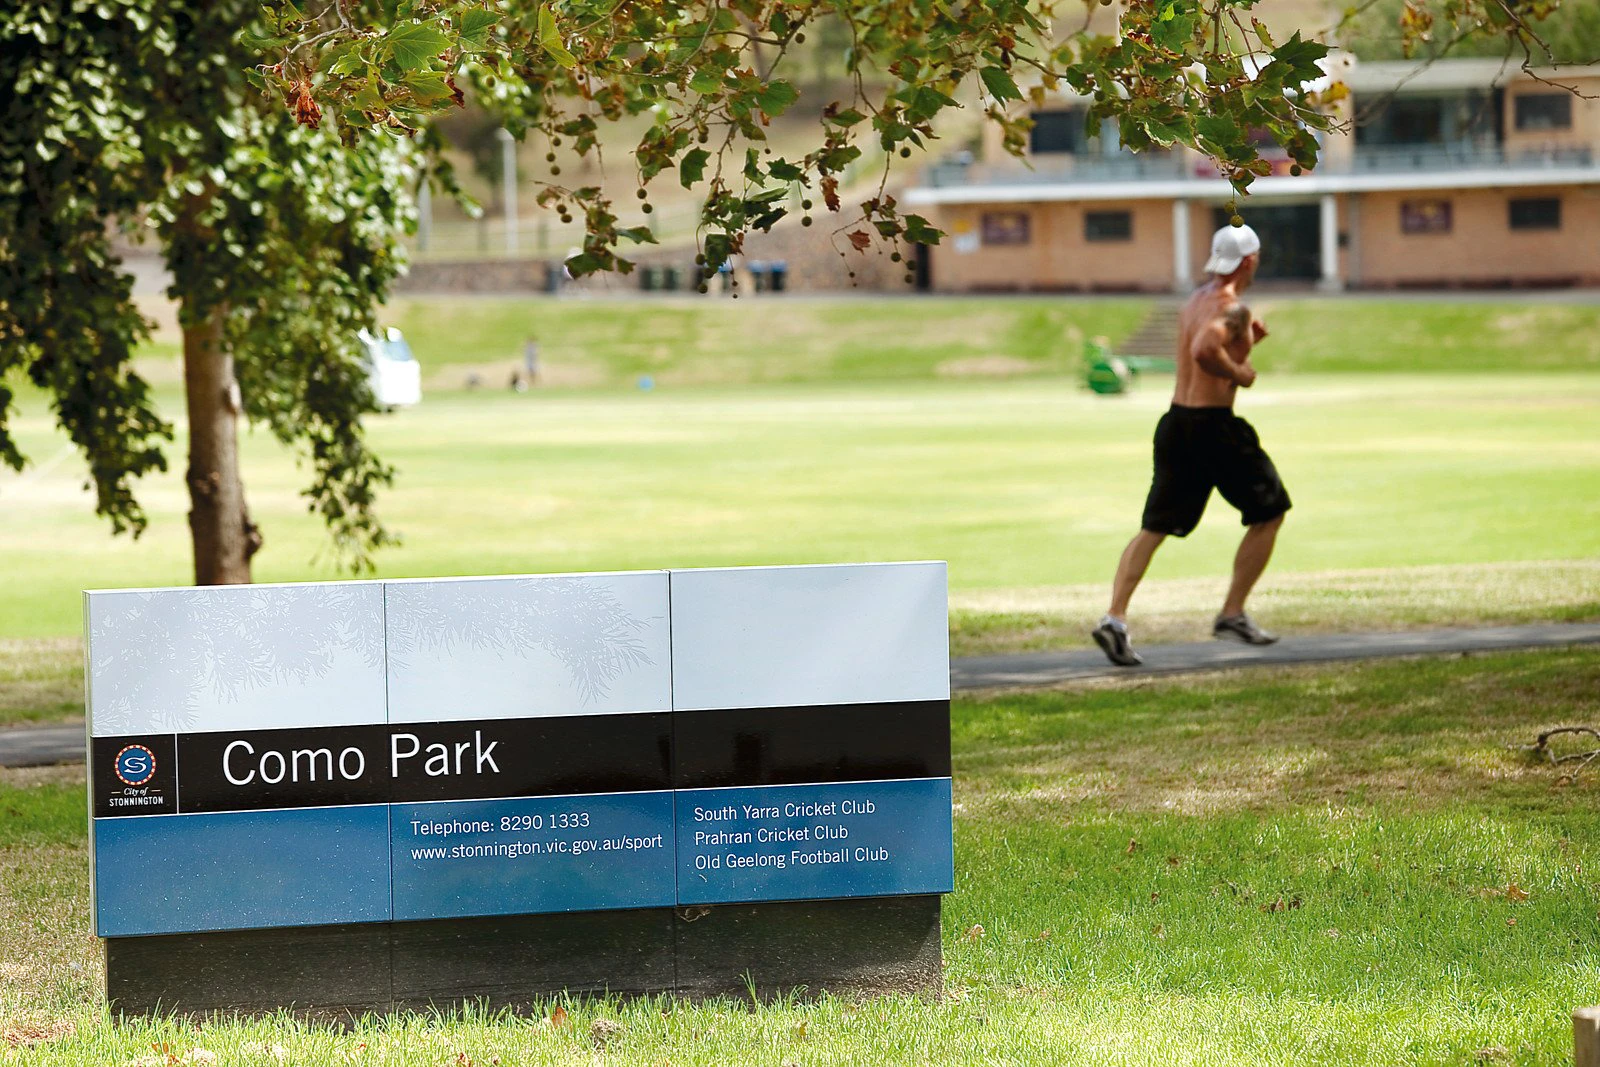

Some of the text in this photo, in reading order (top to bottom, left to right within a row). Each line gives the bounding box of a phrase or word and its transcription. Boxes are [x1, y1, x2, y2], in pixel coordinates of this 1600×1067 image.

[222, 730, 500, 786] Como Park
[109, 796, 164, 807] STONNINGTON
[123, 787, 149, 796] City of
[694, 799, 876, 822] South Yarra Cricket Club
[410, 812, 590, 838] Telephone: 8290 1333
[695, 825, 849, 846] Prahran Cricket Club
[411, 834, 663, 860] www.stonnington.vic.gov.au/sport
[695, 847, 889, 870] Old Geelong Football Club
